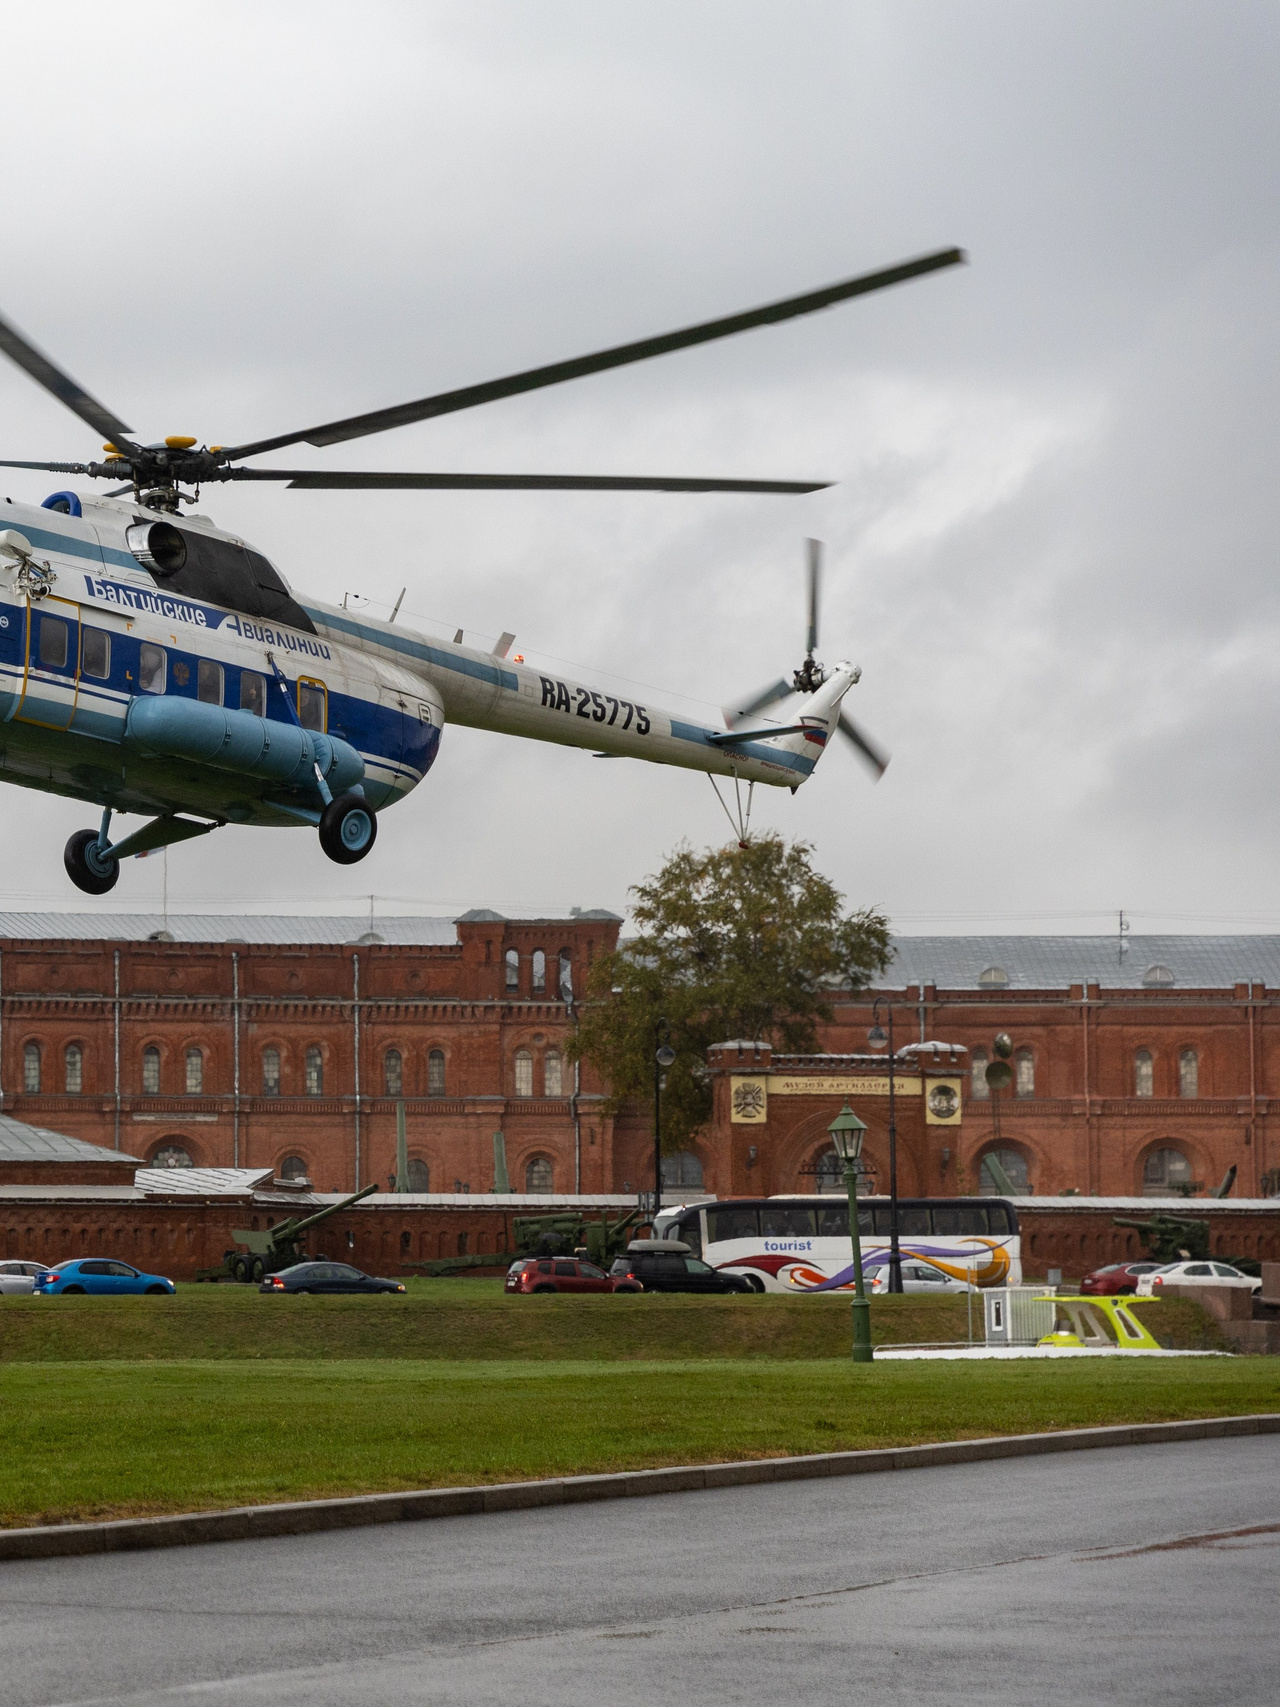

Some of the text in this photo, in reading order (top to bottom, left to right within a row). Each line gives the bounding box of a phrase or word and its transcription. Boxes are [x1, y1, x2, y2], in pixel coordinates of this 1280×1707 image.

[92, 578, 332, 661] Балтийские Авиалинии
[538, 675, 651, 736] RA-25775
[764, 1239, 812, 1251] tourist
